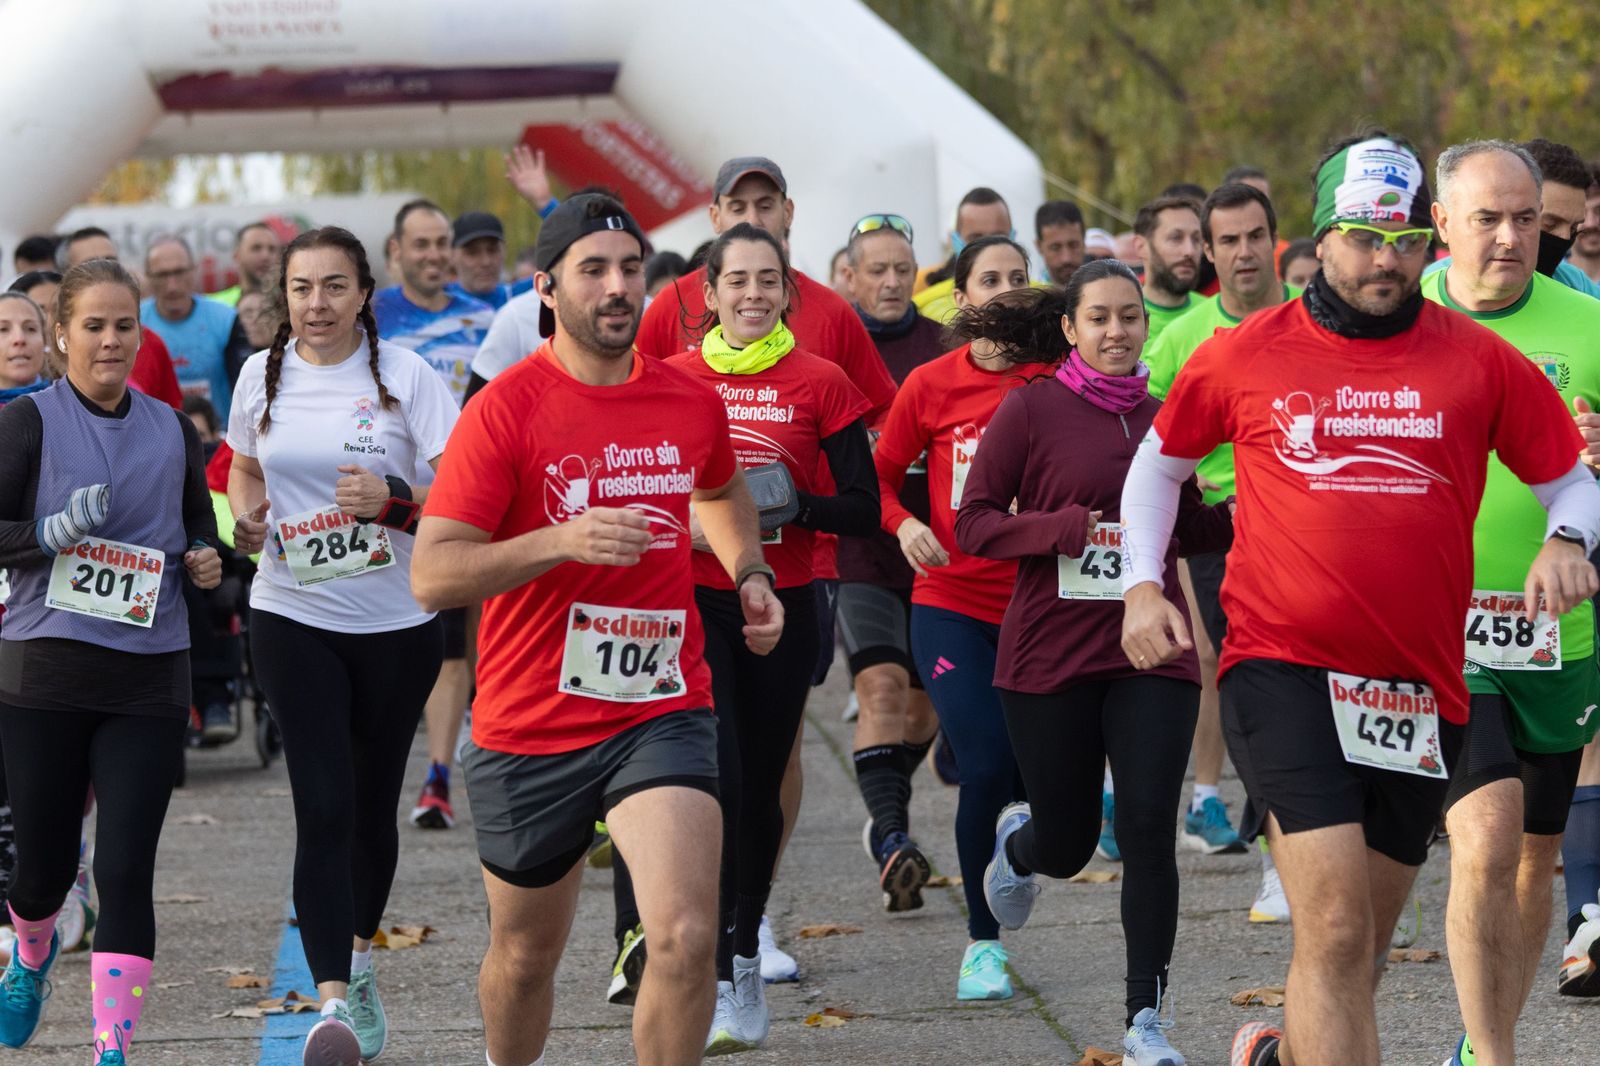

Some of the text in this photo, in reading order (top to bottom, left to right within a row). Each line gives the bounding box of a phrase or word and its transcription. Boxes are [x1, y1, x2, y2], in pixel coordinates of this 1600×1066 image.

[757, 386, 778, 403] sin
[1336, 386, 1421, 412] ¡Corre sin
[1323, 411, 1443, 439] resistencias!
[344, 443, 366, 453] Reina
[604, 440, 680, 472] ¡Corre sin
[598, 466, 695, 498] resistencias!
[280, 510, 356, 541] bedun
[306, 526, 370, 567] 284
[73, 564, 135, 602] 201
[572, 608, 682, 639] bedunia
[1466, 614, 1535, 648] 458
[596, 640, 660, 678] 104
[1332, 679, 1436, 716] bedunia
[1357, 713, 1415, 752] 429
